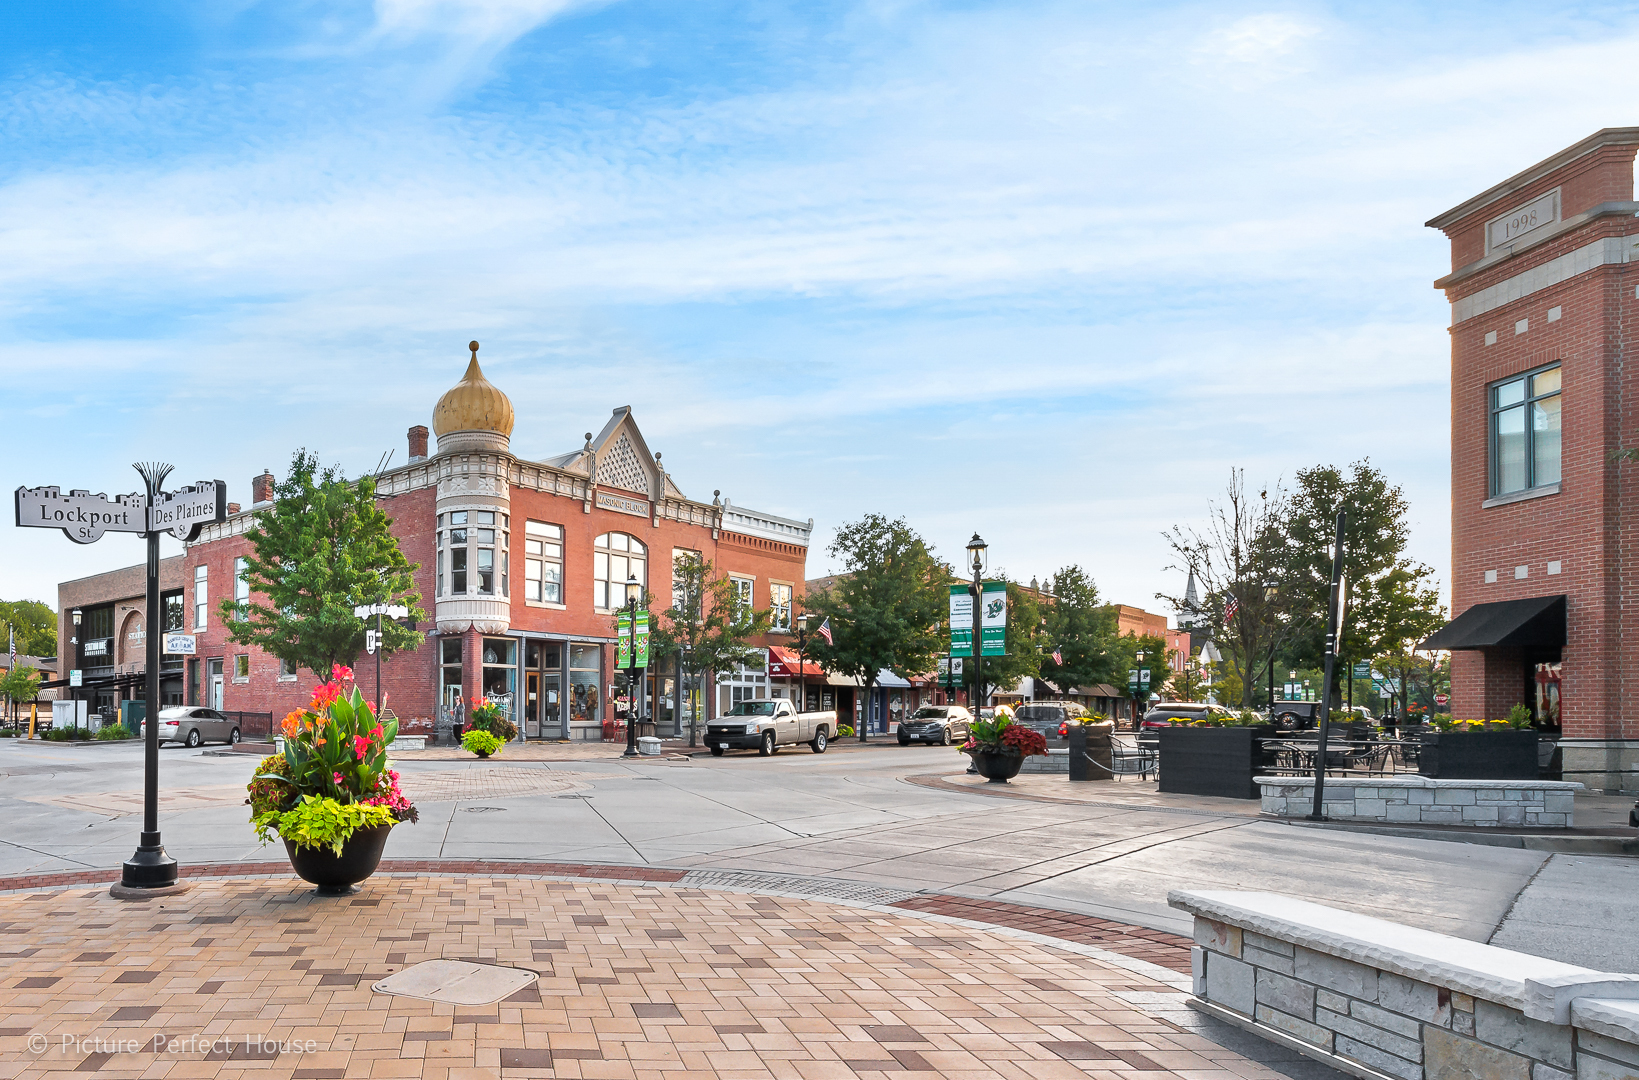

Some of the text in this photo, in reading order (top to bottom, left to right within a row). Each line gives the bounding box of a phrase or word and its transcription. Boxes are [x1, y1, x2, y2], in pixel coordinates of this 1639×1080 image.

[1505, 210, 1537, 238] 1998
[155, 501, 214, 524] Des Plaines
[598, 495, 647, 514] MASONIC BLOCK
[40, 504, 128, 528] Lockport
[79, 527, 94, 538] St.
[128, 631, 146, 641] STATIO
[368, 635, 374, 647] P
